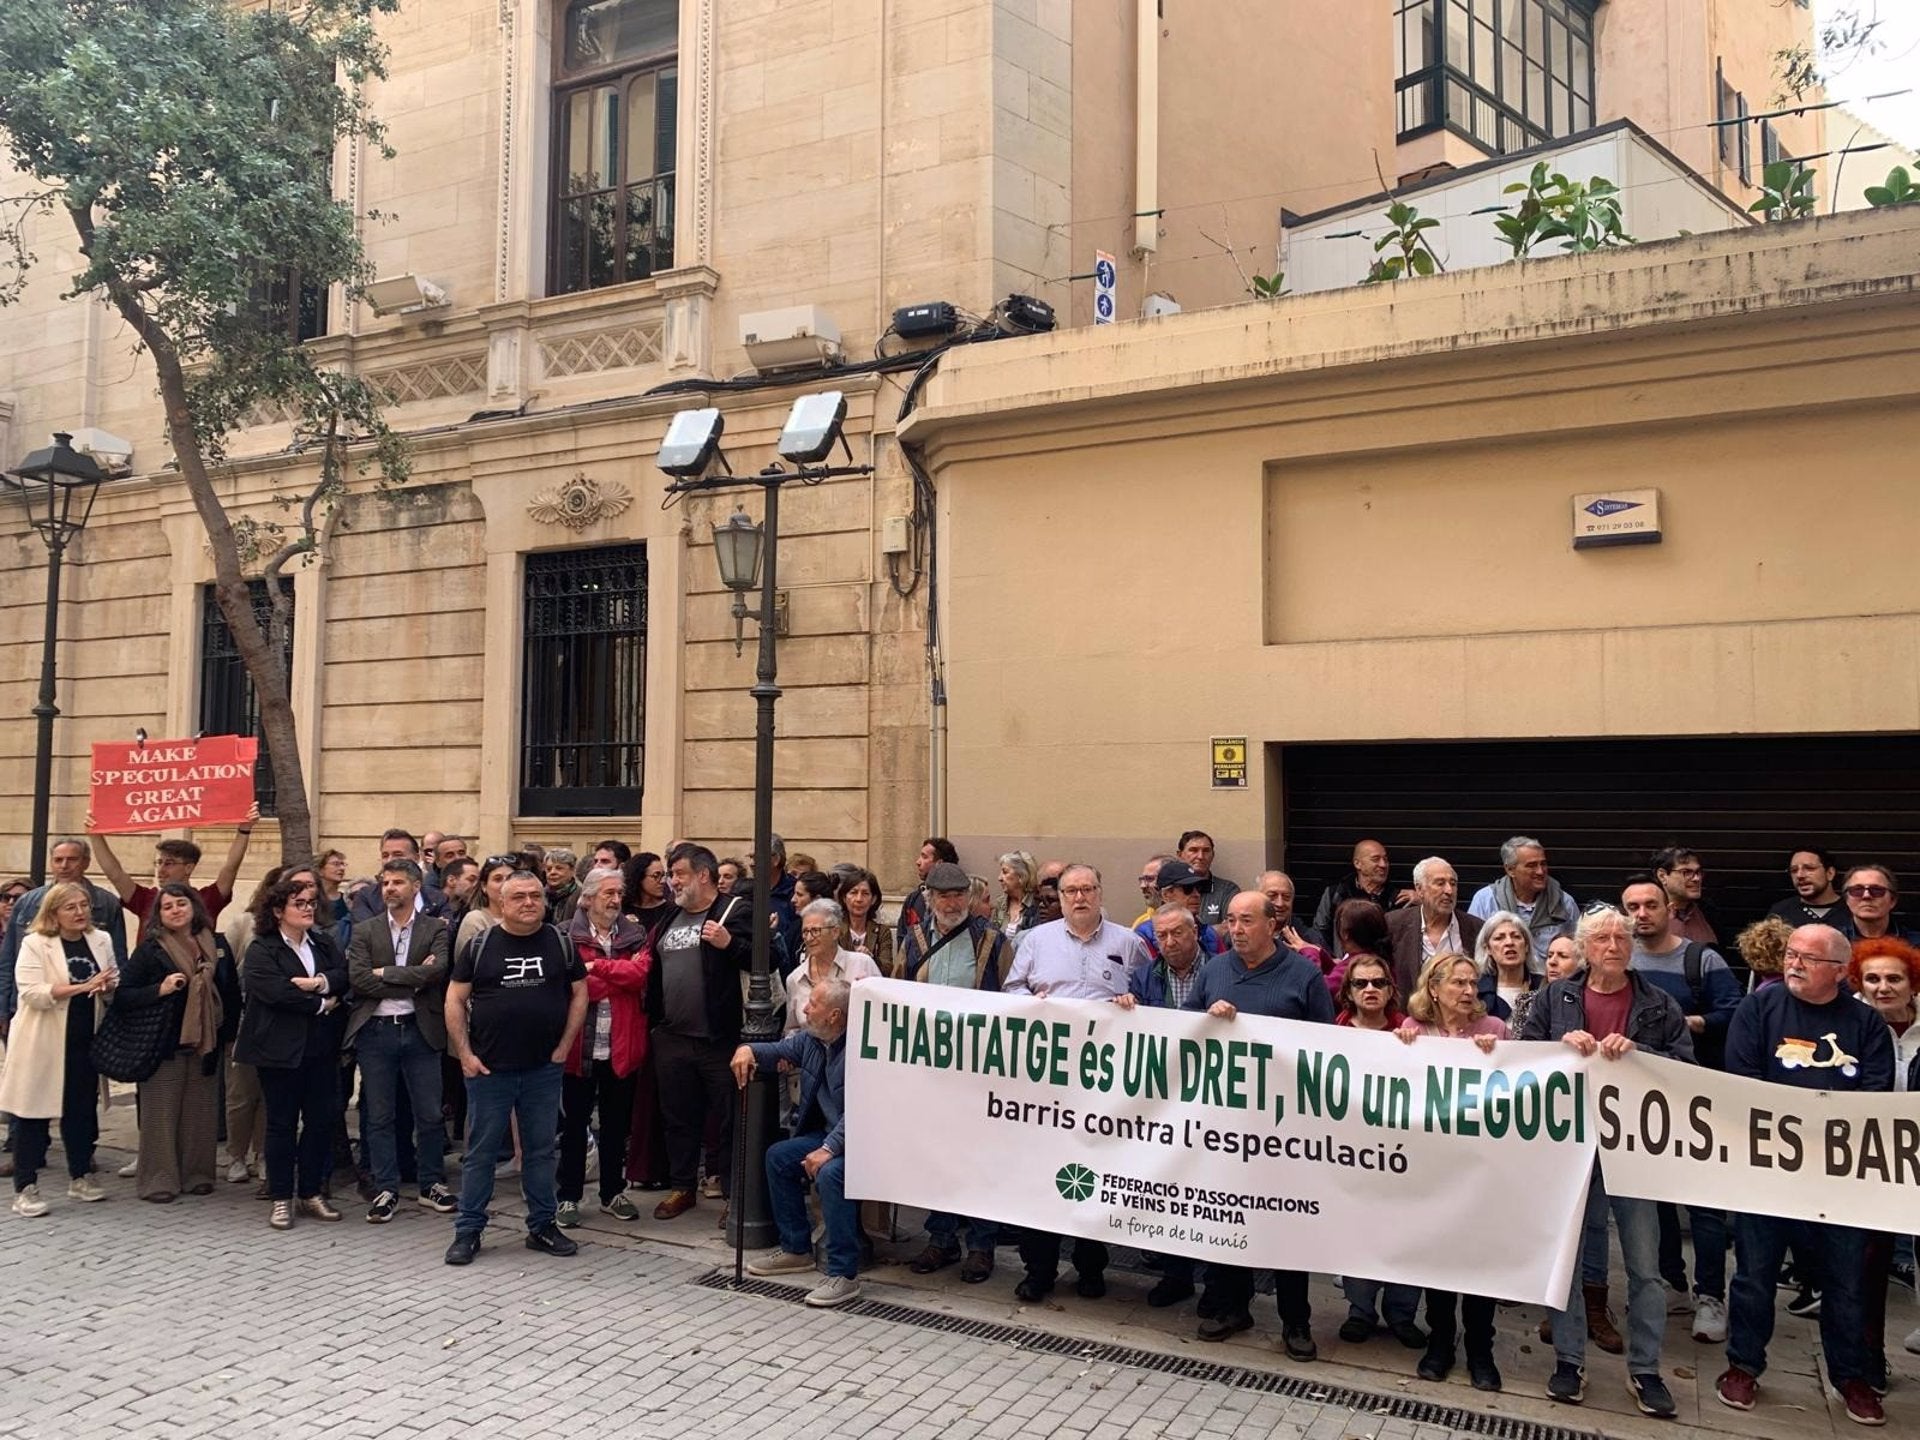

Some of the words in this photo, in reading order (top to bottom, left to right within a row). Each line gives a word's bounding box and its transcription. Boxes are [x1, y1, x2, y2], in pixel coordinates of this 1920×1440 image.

[128, 747, 197, 764] MAKE
[91, 763, 251, 786] SPECULATION
[125, 786, 205, 806] GREAT
[126, 804, 202, 824] AGAIN
[860, 1000, 1071, 1086] L'HABITATGE
[1079, 1020, 1116, 1093] és
[1122, 1031, 1169, 1100] UN
[1179, 1038, 1285, 1127] DRET,
[1296, 1048, 1351, 1121] NO
[1362, 1073, 1411, 1130] un
[1424, 1065, 1585, 1143] NEGOCI
[987, 1091, 1077, 1130] barris
[1084, 1114, 1174, 1145] contra
[1183, 1119, 1408, 1174] l'especulació
[1598, 1084, 1729, 1163] S.O.S.
[1749, 1106, 1804, 1173] ES
[1100, 1189, 1117, 1205] DE
[1121, 1193, 1166, 1213] VEÏNS
[1170, 1201, 1189, 1217] DE
[1193, 1204, 1246, 1225] PALMA
[1102, 1173, 1180, 1198] FEDERACIÓ
[1184, 1186, 1320, 1215] D'ASSOCIACIONS
[1109, 1214, 1122, 1229] la
[1127, 1216, 1164, 1237] força
[1169, 1224, 1186, 1241] de
[1190, 1228, 1204, 1243] la
[1209, 1233, 1248, 1250] unió
